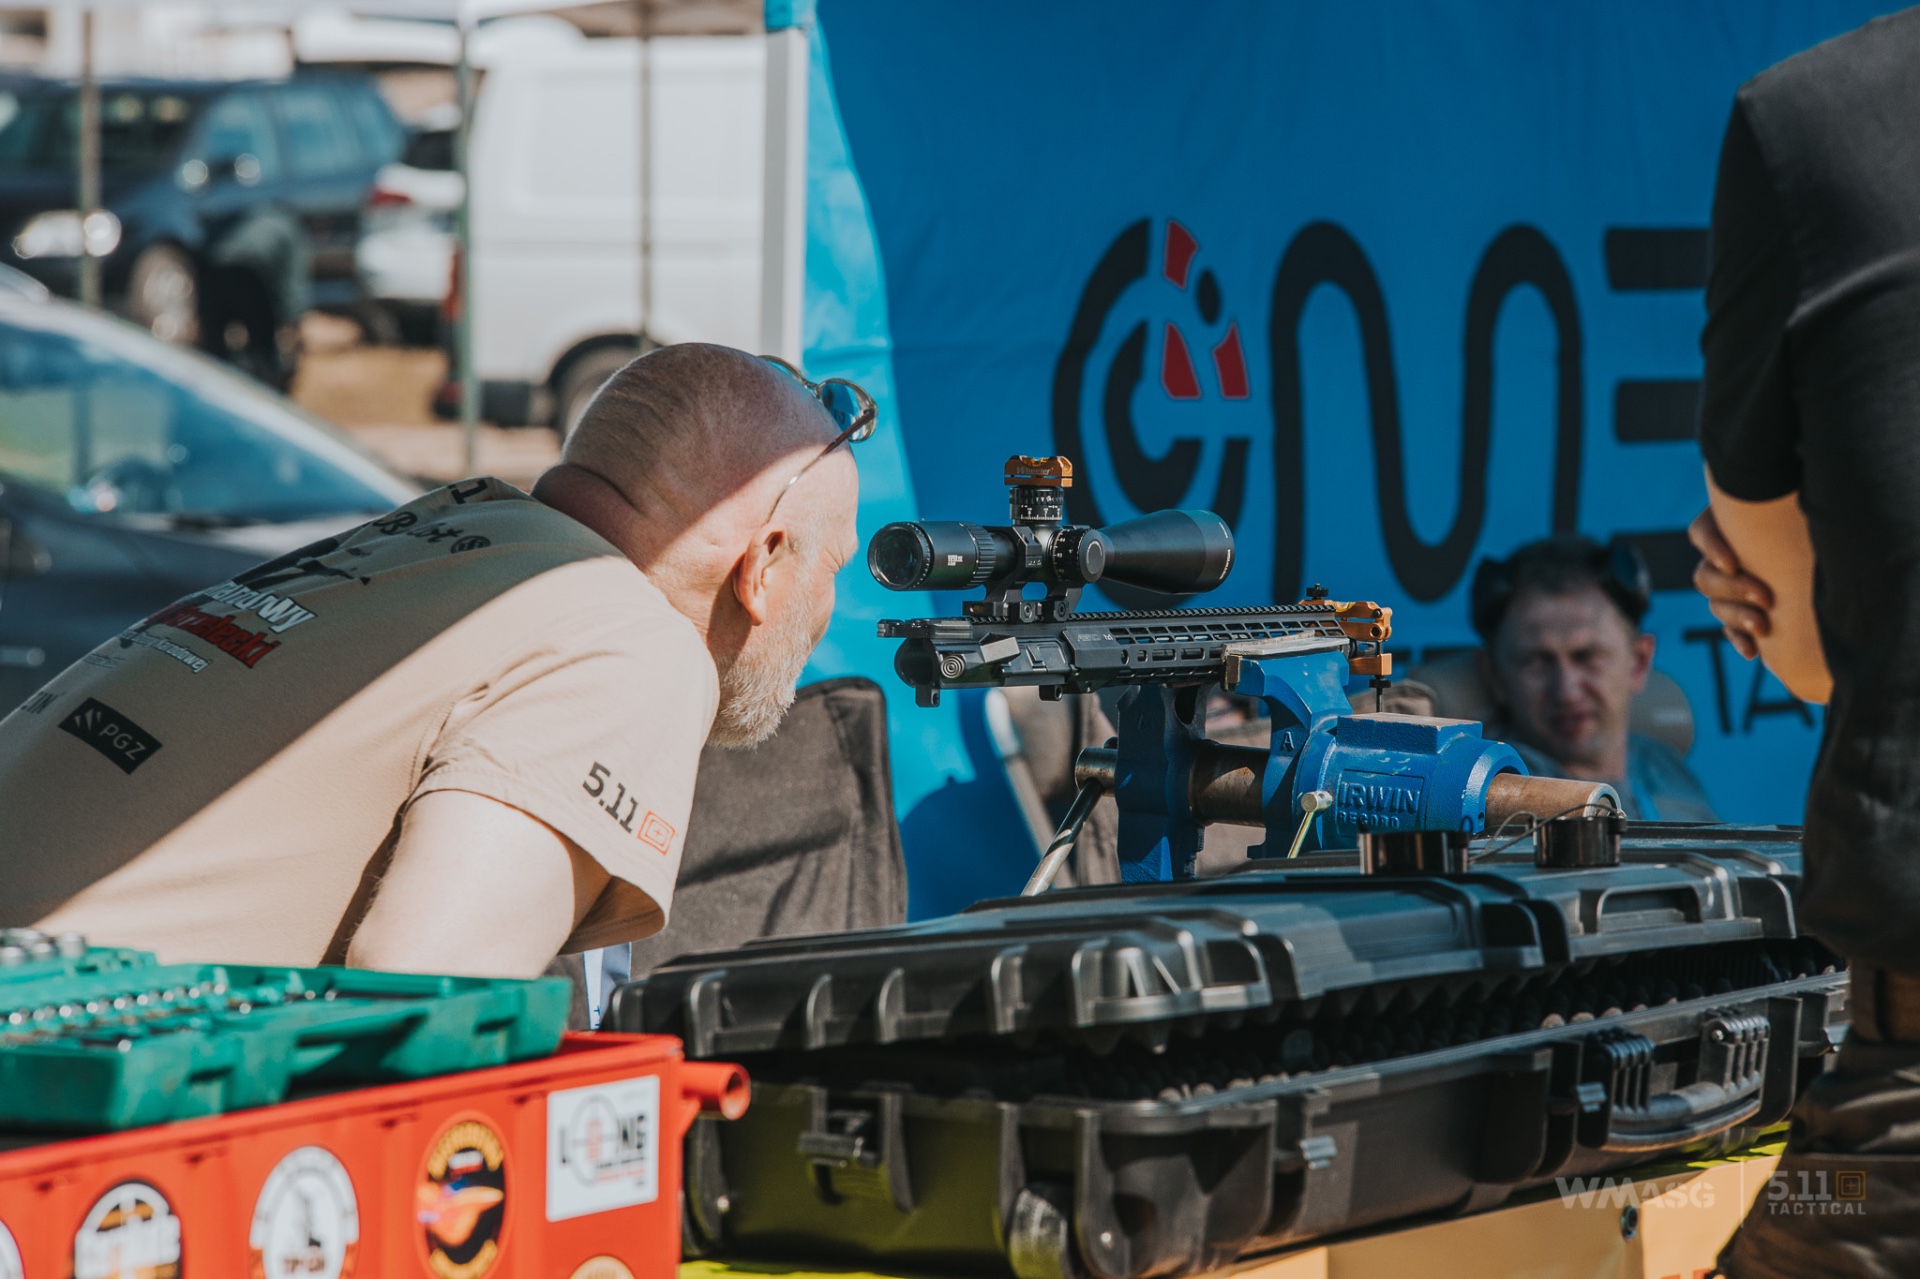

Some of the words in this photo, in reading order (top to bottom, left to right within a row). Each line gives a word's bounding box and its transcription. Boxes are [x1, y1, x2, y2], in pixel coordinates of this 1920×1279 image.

[99, 723, 147, 761] PGZ
[582, 761, 638, 834] 5.11
[1337, 781, 1421, 814] IRWIN
[1337, 810, 1401, 829] RECORD
